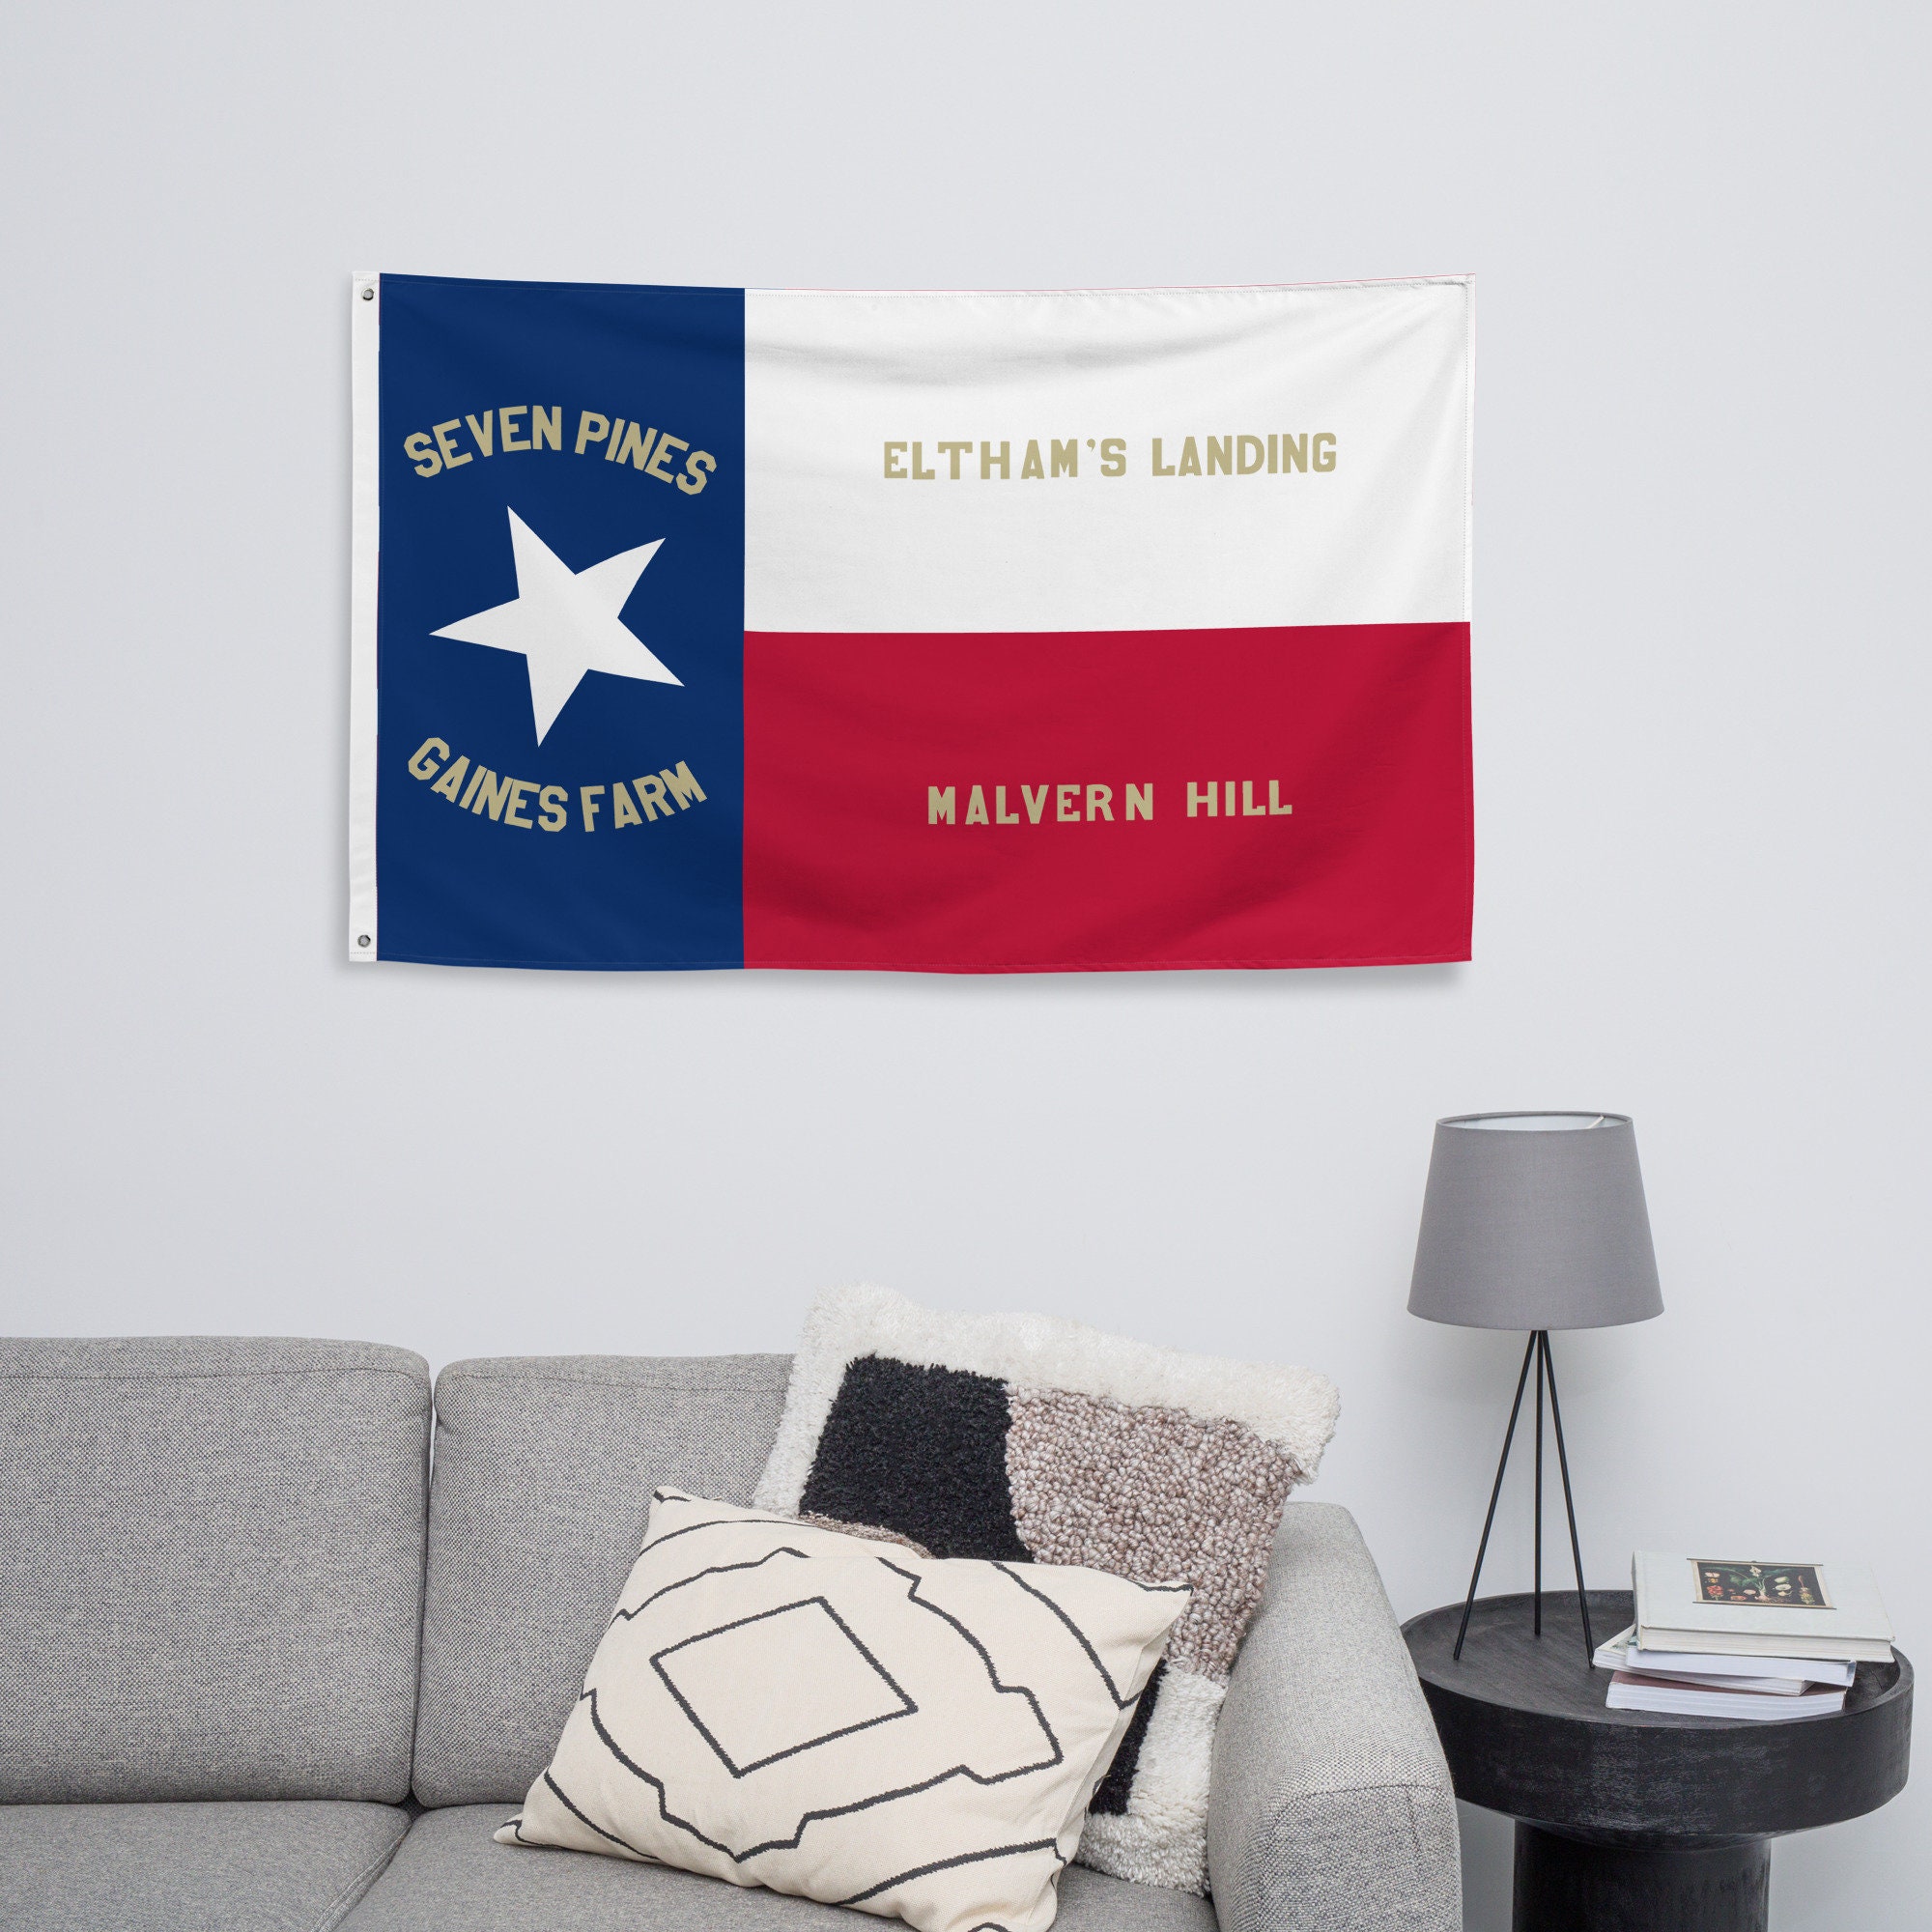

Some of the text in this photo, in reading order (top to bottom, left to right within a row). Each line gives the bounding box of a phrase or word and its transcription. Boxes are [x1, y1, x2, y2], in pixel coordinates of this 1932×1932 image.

[404, 405, 717, 495] SEVEN PINES
[883, 432, 1337, 480] ELTHAM'S LANDING
[408, 737, 707, 832] GAINES FARM
[927, 780, 1293, 825] MALVERN HILL
